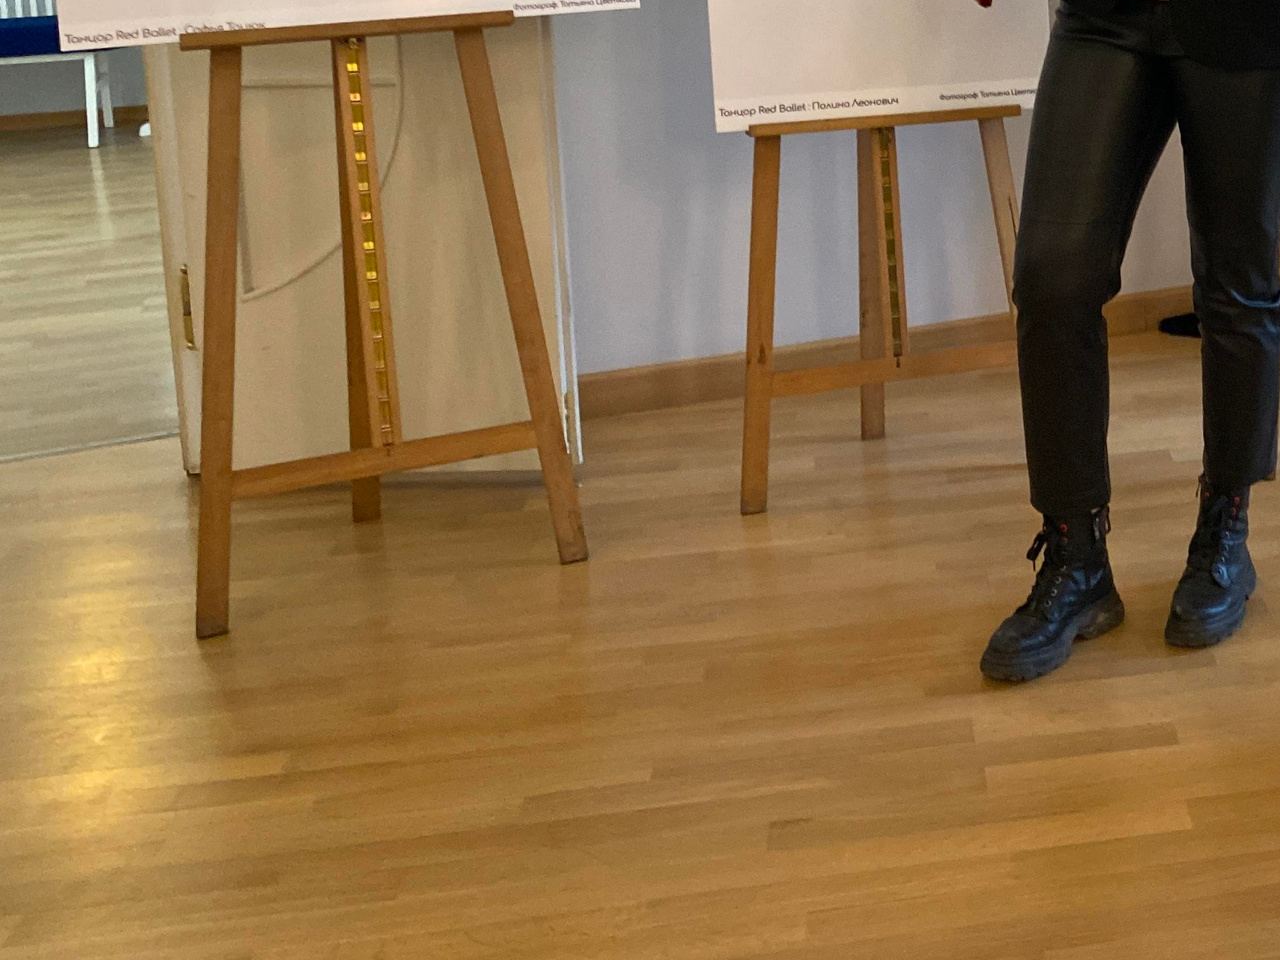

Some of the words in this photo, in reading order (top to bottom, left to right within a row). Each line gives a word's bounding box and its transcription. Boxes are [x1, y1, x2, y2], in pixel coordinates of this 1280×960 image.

[64, 33, 112, 44] Танцор
[115, 29, 139, 40] Red
[142, 26, 176, 38] Ballet
[1011, 88, 1037, 96] Цветк
[719, 108, 756, 118] Танцор
[758, 105, 776, 114] Red
[779, 103, 806, 113] Ballet
[811, 101, 850, 110] Полина
[851, 97, 899, 107] Леонович
